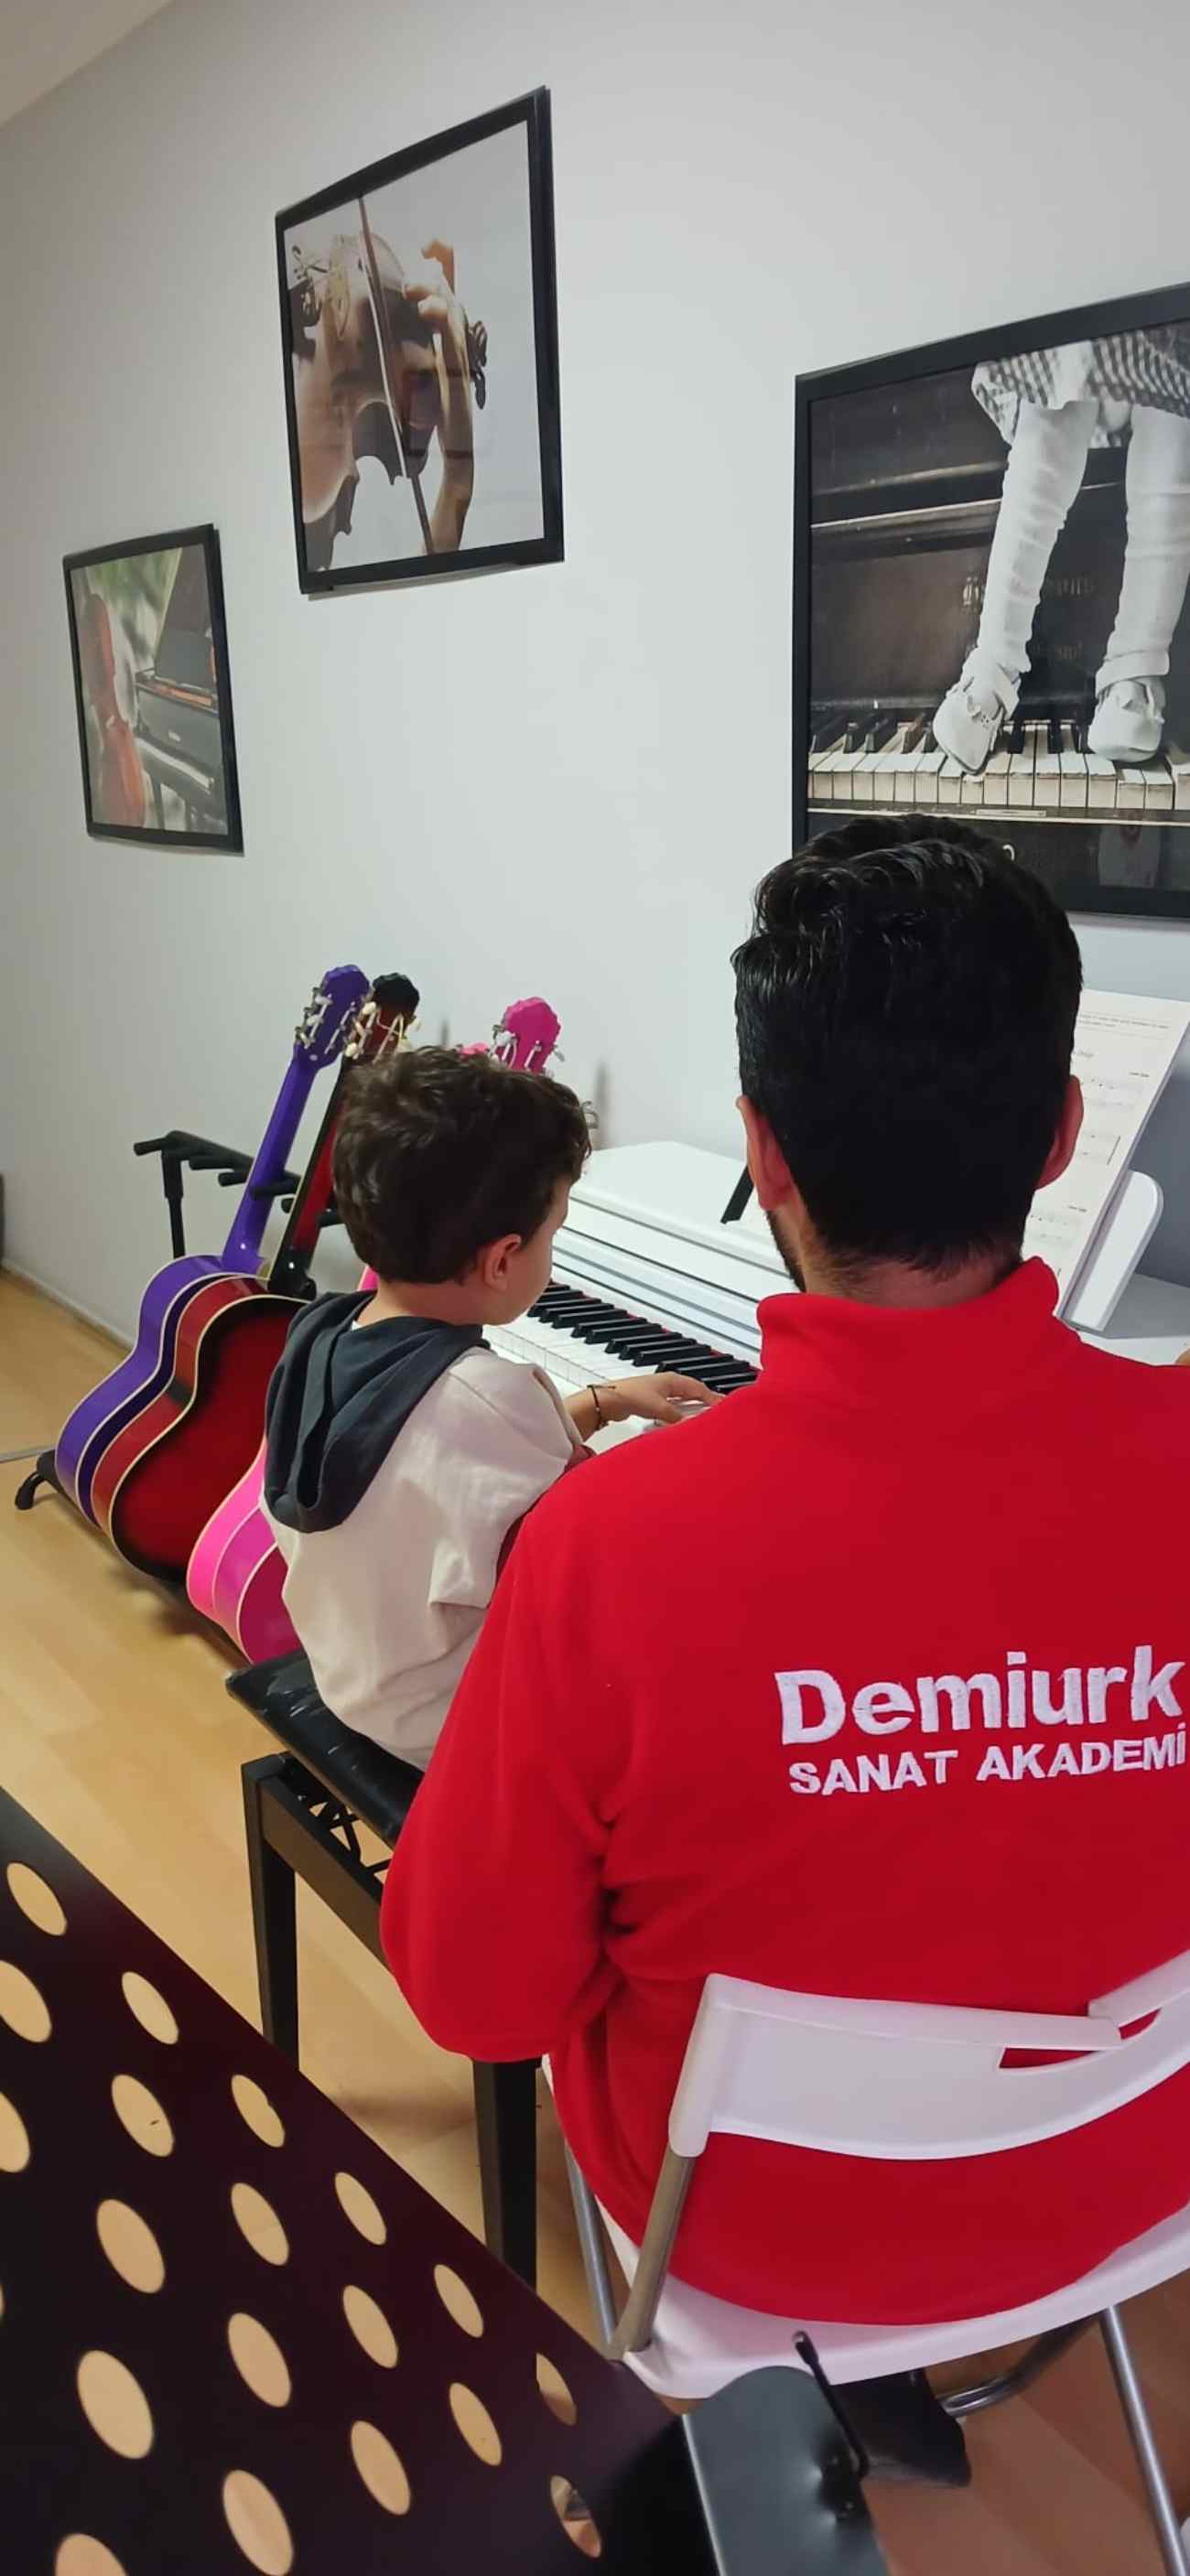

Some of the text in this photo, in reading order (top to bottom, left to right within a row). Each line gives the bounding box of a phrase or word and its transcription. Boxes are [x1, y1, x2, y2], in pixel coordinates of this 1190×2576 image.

[774, 1644, 1185, 1745] Demiurk
[789, 1722, 1186, 1795] SANAT AKADEMİ
